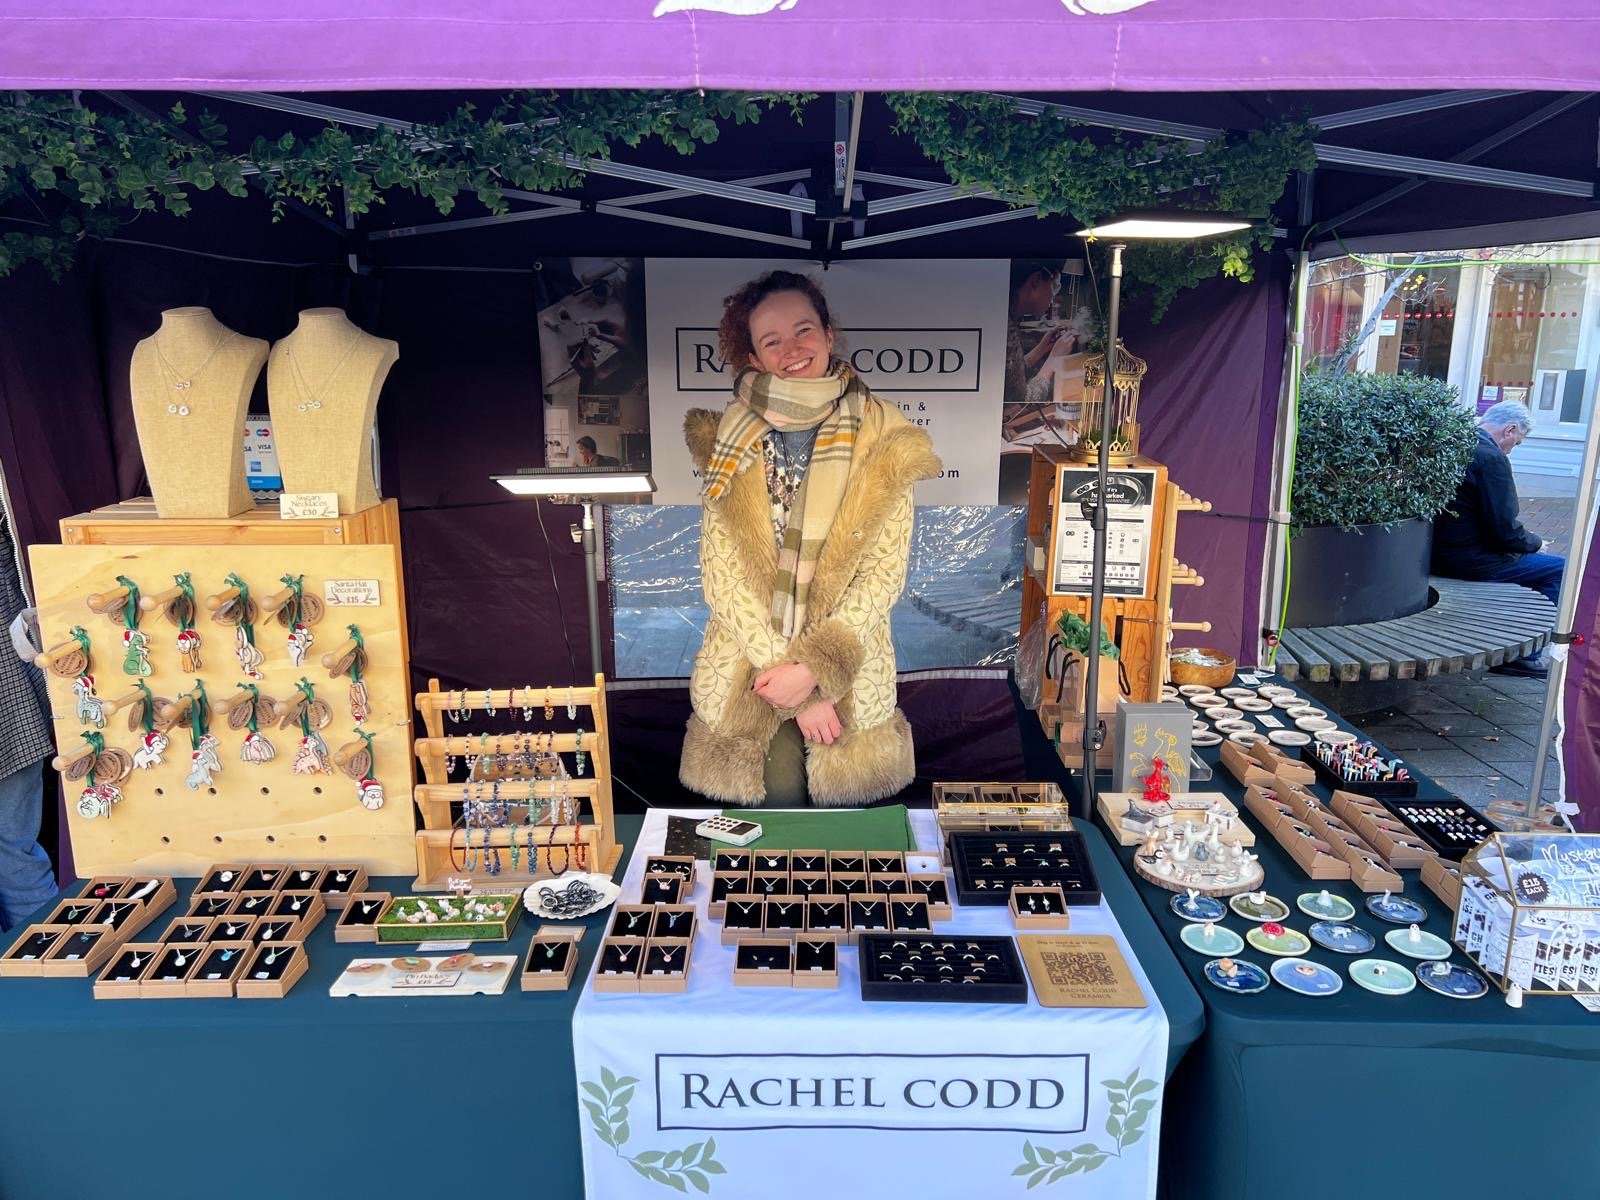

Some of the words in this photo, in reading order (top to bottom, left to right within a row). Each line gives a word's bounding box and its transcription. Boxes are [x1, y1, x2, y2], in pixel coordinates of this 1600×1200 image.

[850, 348, 965, 374] CODD
[917, 401, 927, 412] &
[335, 580, 355, 588] Santa
[355, 580, 368, 588] Hat
[1522, 877, 1541, 889] £15
[1525, 885, 1545, 896] EACH
[680, 1072, 887, 1109] RACHEL
[902, 1078, 1066, 1110] CODD
